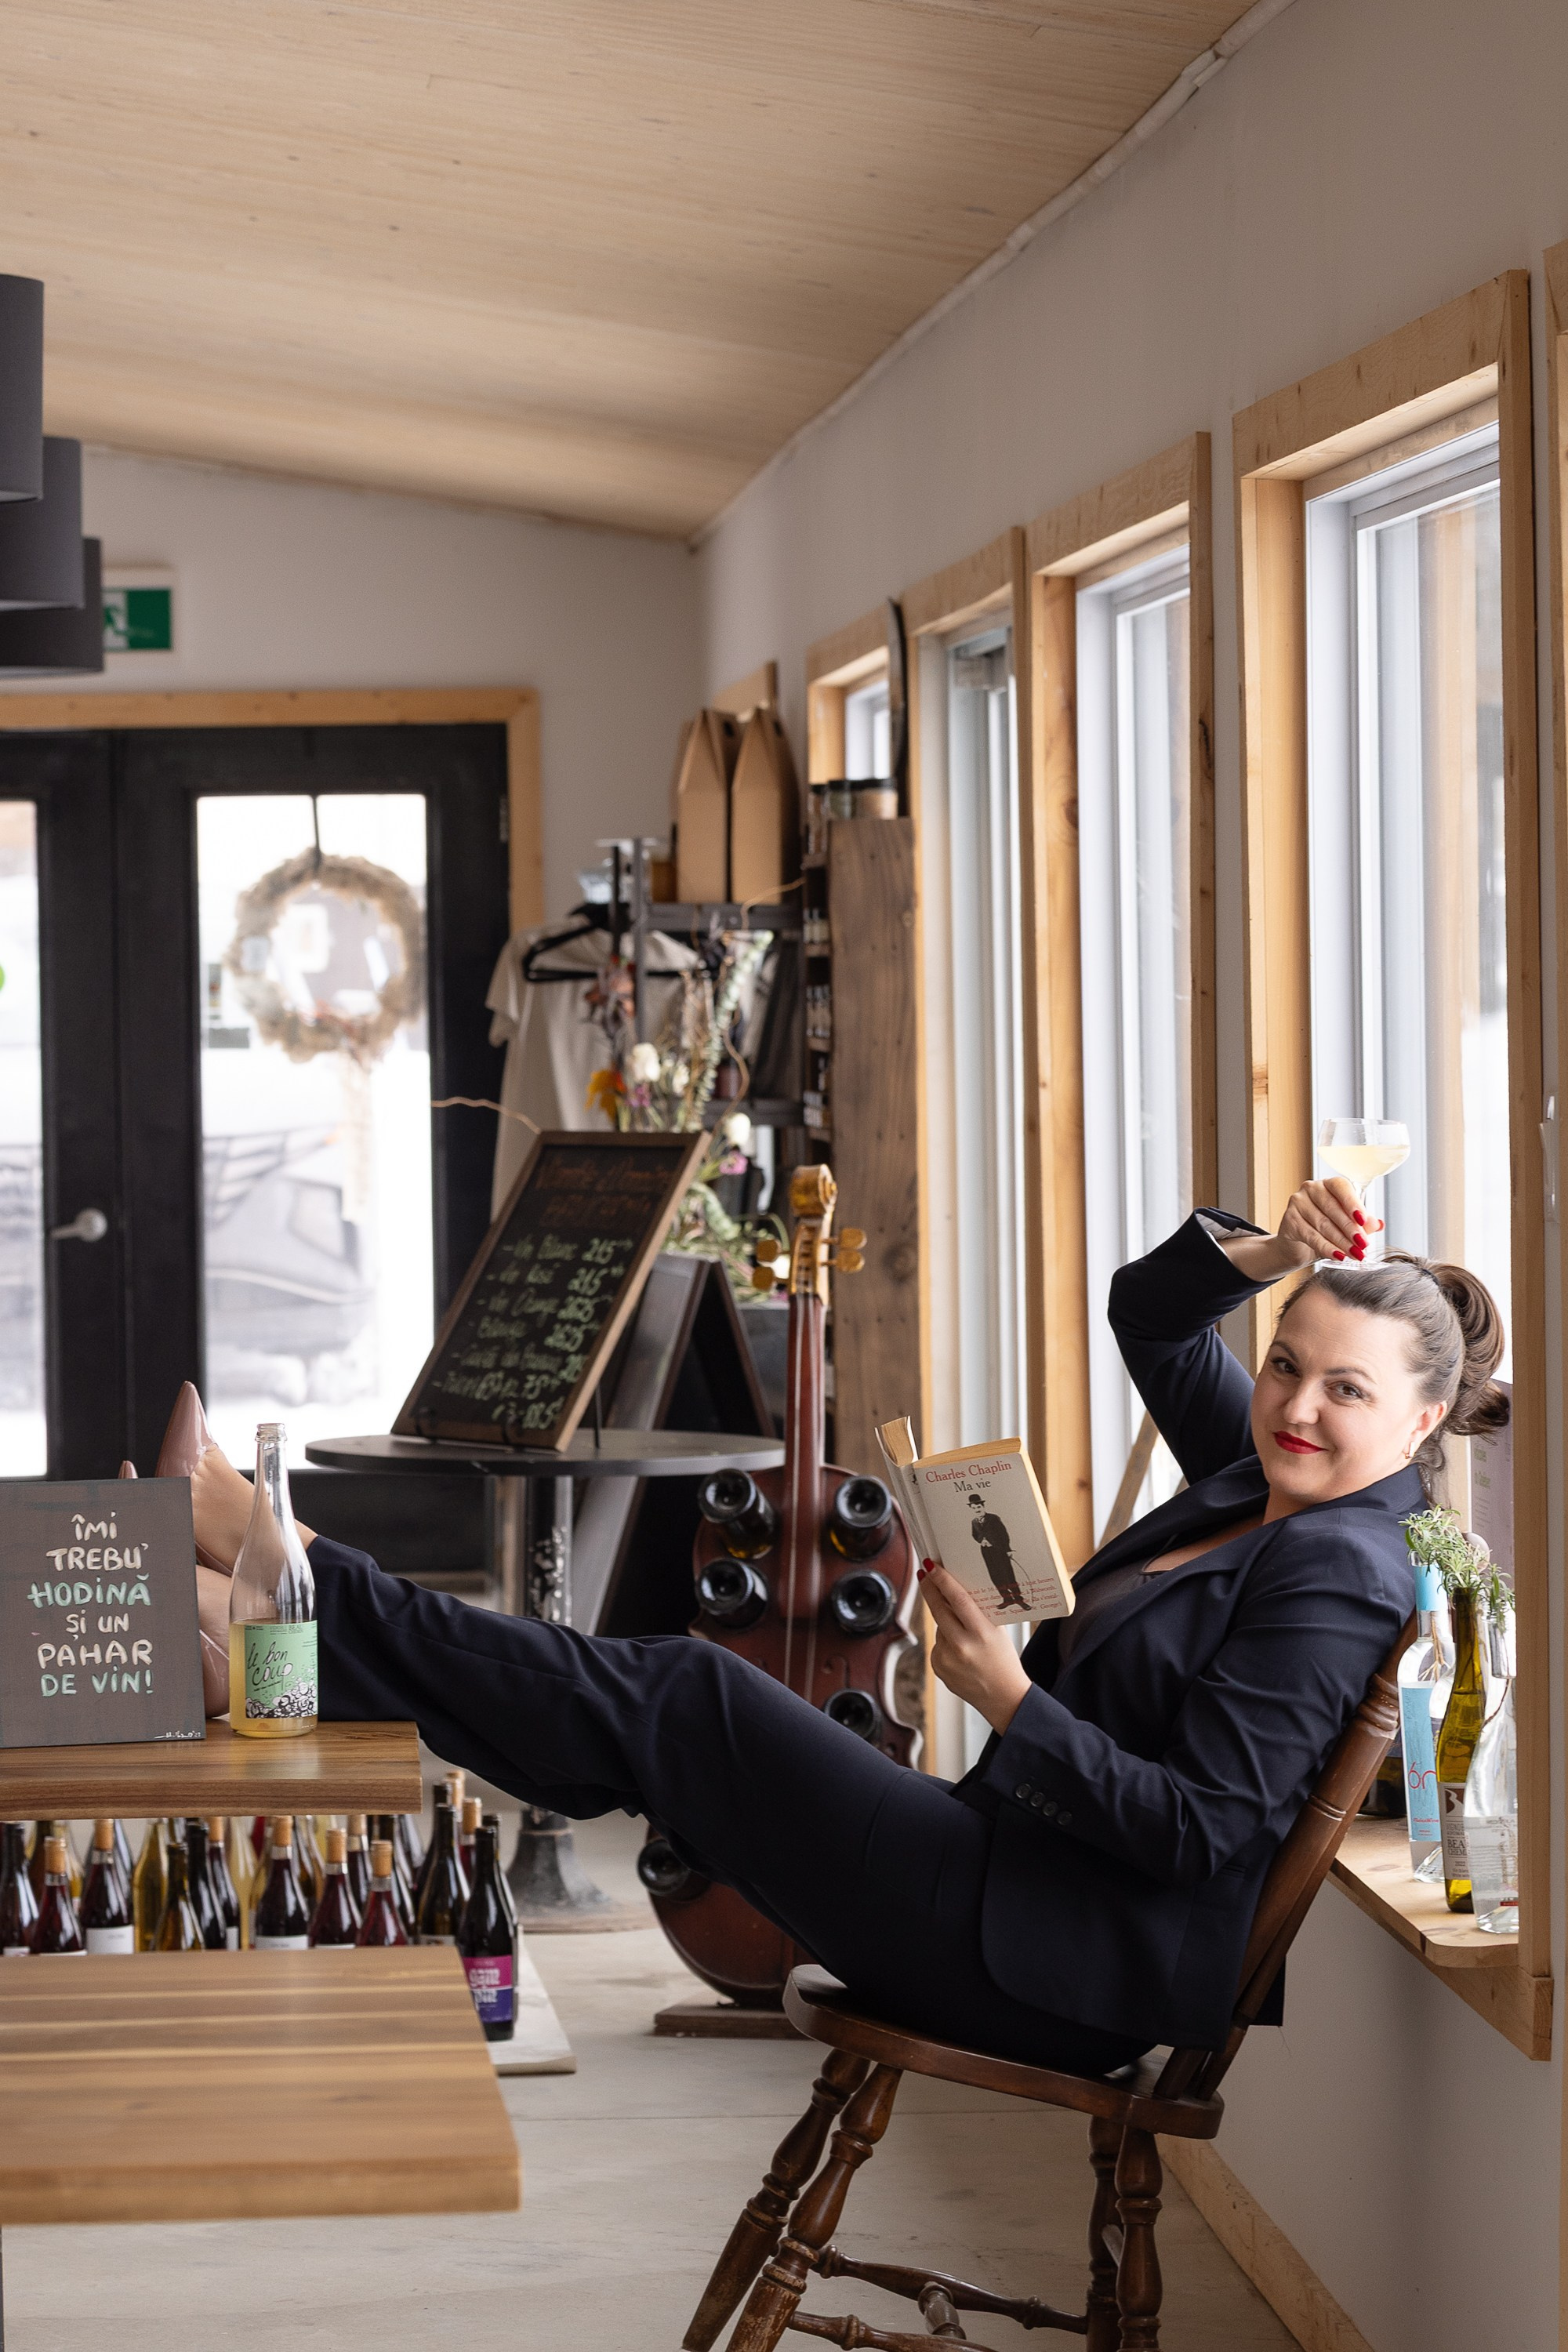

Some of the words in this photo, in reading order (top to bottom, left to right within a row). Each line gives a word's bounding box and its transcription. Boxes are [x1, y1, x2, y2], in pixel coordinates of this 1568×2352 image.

[925, 1468, 967, 1483] Charles
[968, 1461, 1012, 1478] Chaplin
[953, 1481, 974, 1493] Ma
[976, 1478, 992, 1490] vie
[98, 1613, 129, 1633] UN
[37, 1639, 154, 1670] PAHAR
[263, 1641, 289, 1665] bon
[40, 1674, 77, 1697] DE
